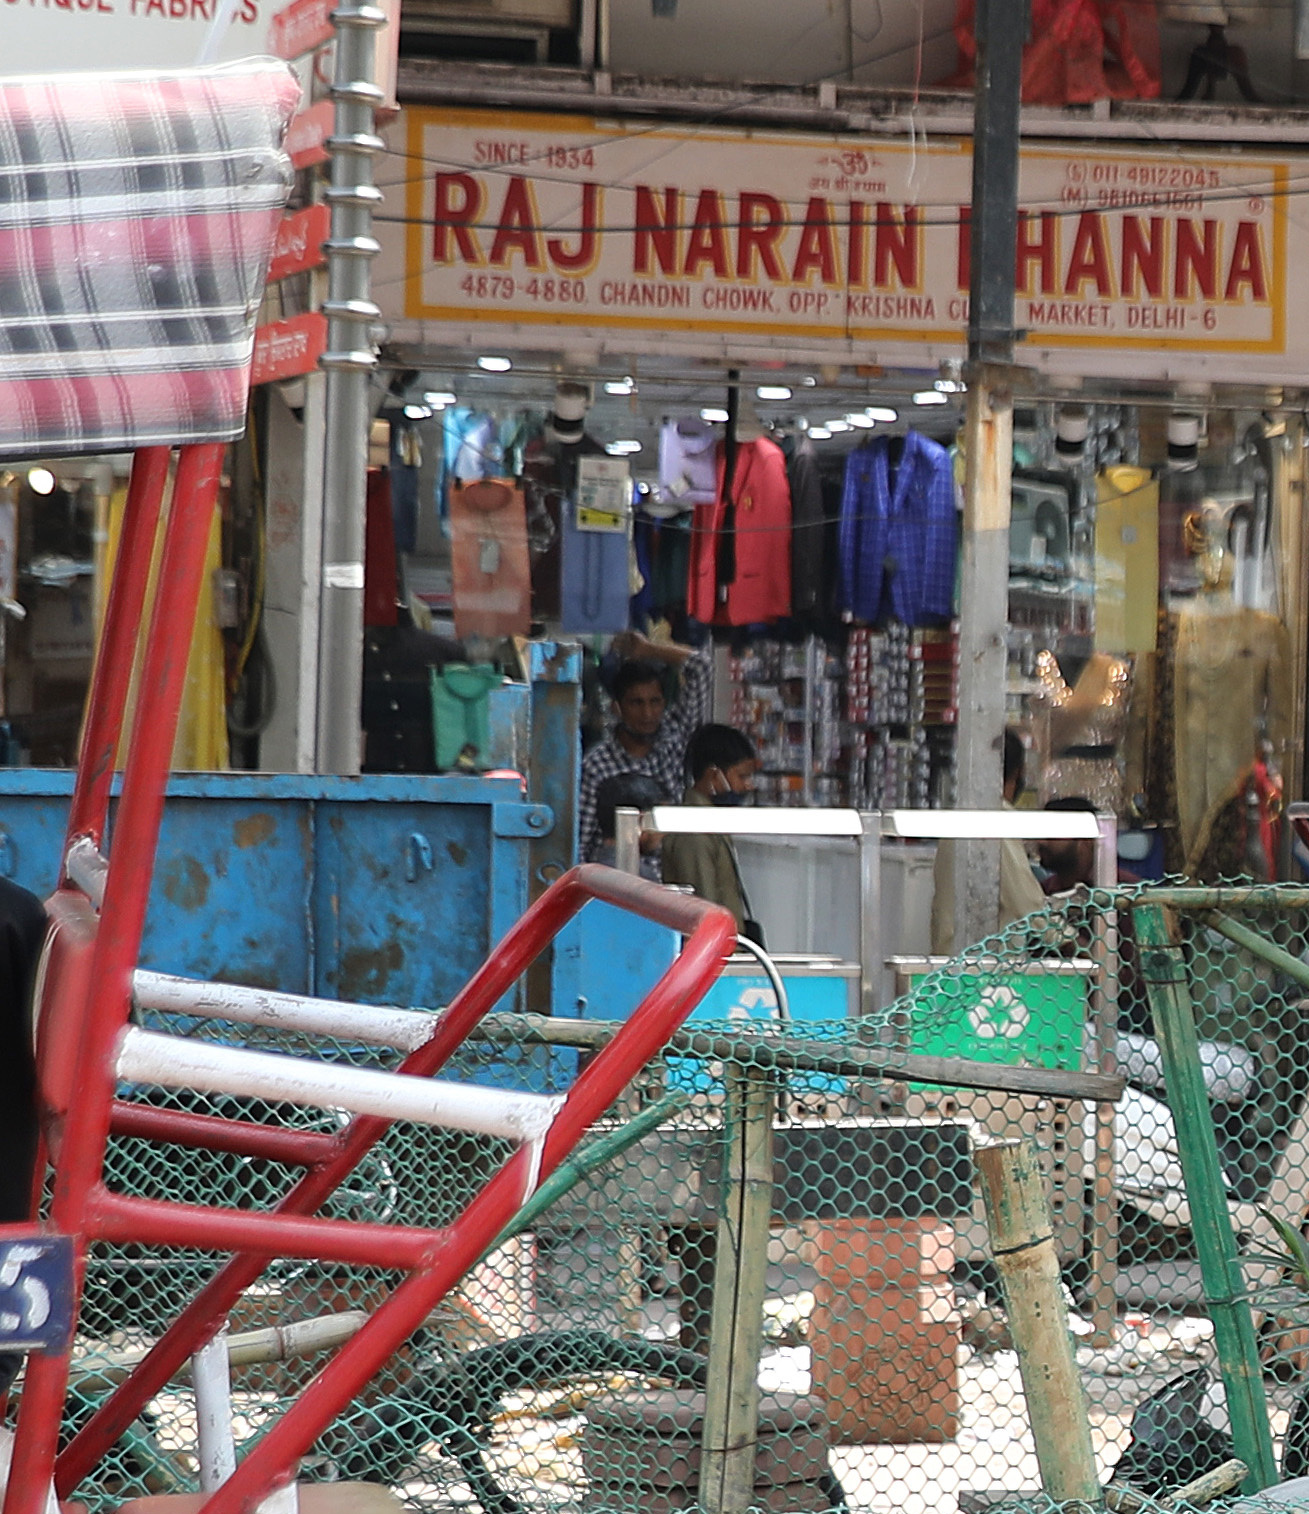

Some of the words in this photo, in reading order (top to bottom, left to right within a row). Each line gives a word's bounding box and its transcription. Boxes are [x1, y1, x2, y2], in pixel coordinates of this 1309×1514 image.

[474, 140, 529, 165] SINCE
[546, 144, 595, 169] 1934
[433, 171, 603, 275] RAJ
[634, 183, 921, 291] NARAIN
[600, 281, 691, 309] CHANDNI
[702, 287, 781, 314] CHOWK,
[847, 295, 936, 321] KRISHNA
[1028, 304, 1114, 330] MARKET,
